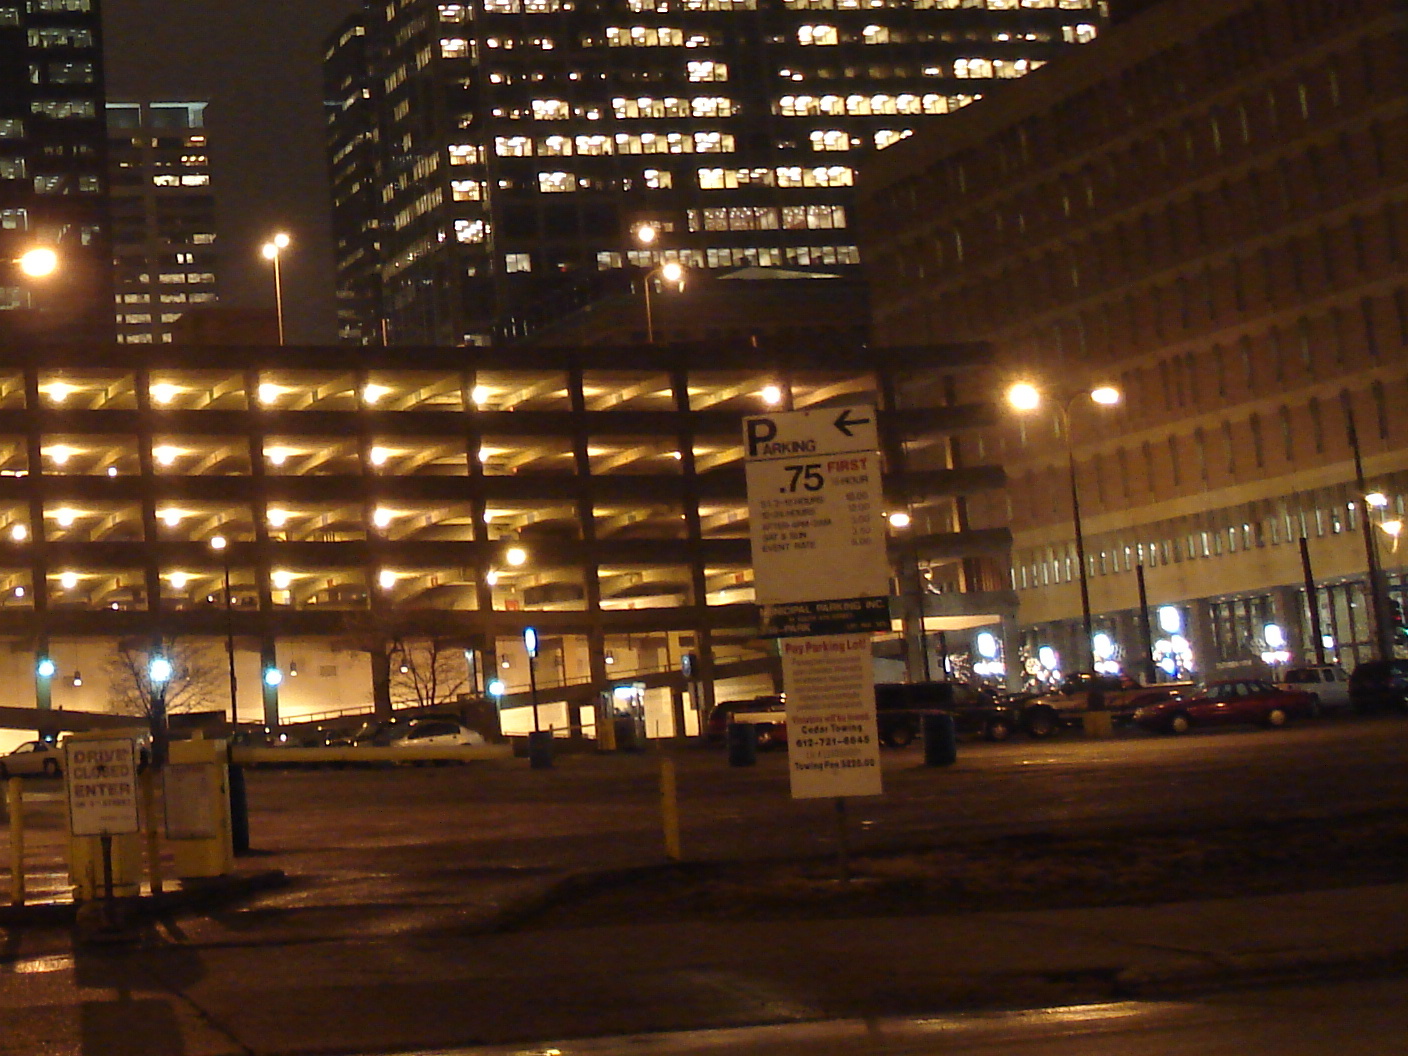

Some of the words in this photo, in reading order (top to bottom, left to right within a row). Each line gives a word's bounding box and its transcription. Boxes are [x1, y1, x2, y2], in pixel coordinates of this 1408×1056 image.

[747, 418, 816, 456] PARKING
[779, 463, 824, 494] .75
[827, 458, 867, 473] FIRST
[815, 601, 862, 612] PARKING
[785, 642, 804, 655] Pay
[805, 641, 845, 654] Parking
[801, 725, 828, 735] Cedar
[831, 723, 862, 733] Towing
[74, 749, 129, 763] DRIVE
[74, 765, 129, 779] CLOSED
[795, 761, 823, 772] Towing
[74, 783, 130, 798] ENTER
